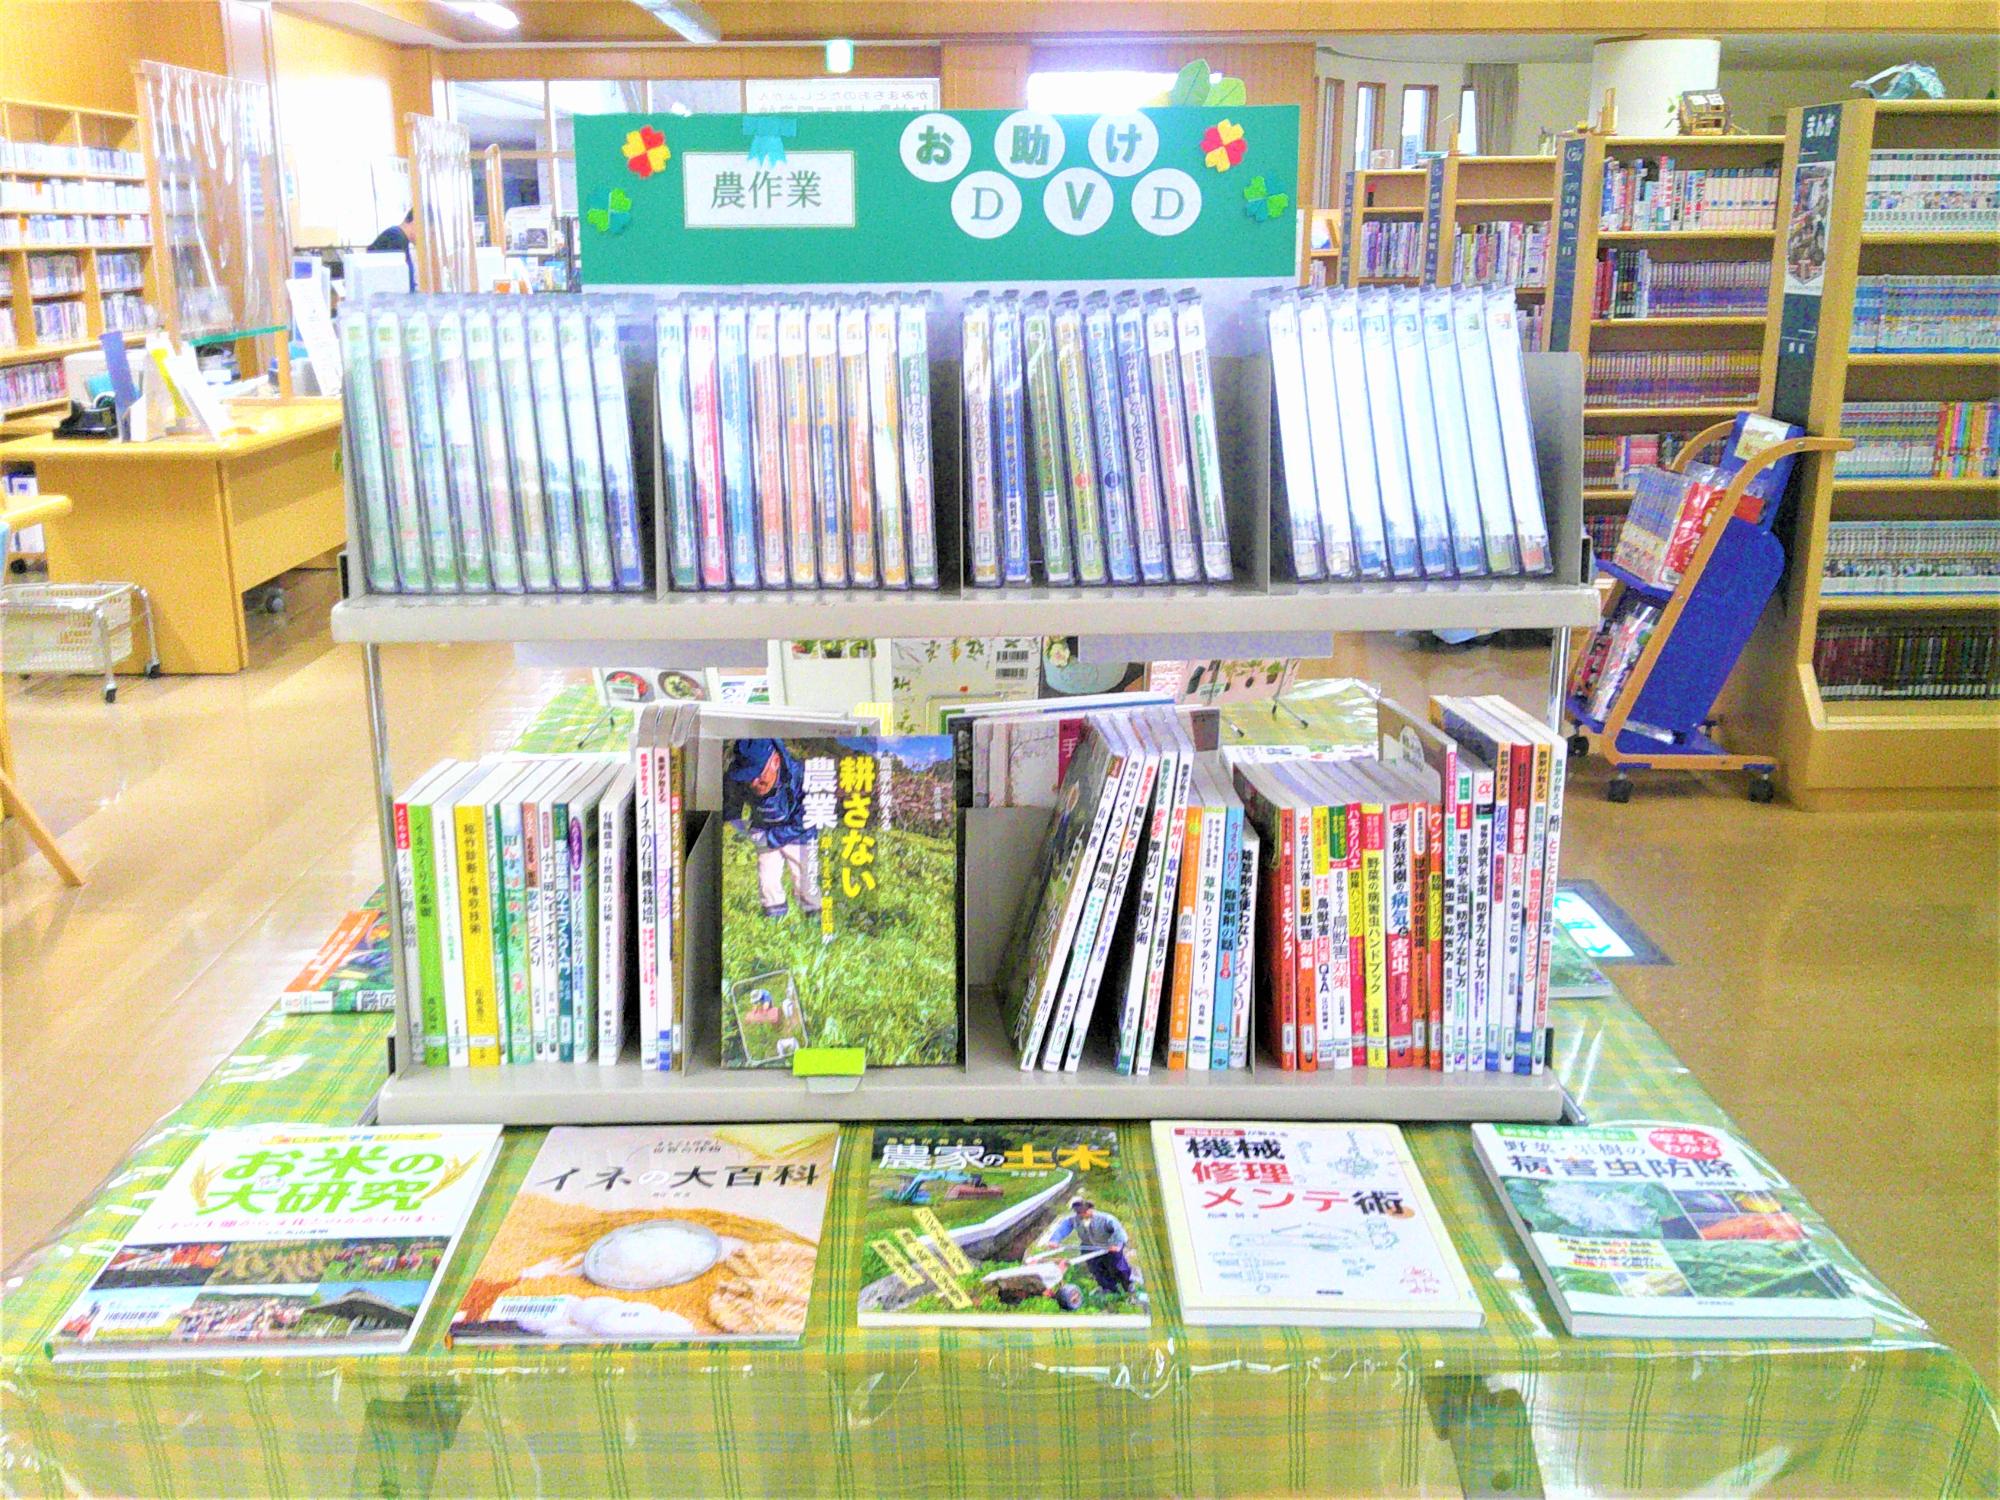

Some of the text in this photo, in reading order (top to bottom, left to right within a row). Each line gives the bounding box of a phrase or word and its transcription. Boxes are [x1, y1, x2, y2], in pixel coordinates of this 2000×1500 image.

[1806, 114, 1836, 138] まんが
[711, 170, 822, 209] 農作業
[641, 754, 650, 796] 農家が教える
[658, 756, 668, 804] 農家が教える
[802, 756, 838, 831] 農業
[879, 757, 893, 831] 農家が教える
[1158, 759, 1171, 805] 農家が教える
[1178, 764, 1190, 805] 農家が教える
[1498, 751, 1509, 799] 農家が教える
[1537, 751, 1548, 800] 農家が教える
[840, 756, 876, 898] 耕さない
[1431, 812, 1442, 858] ウンカ
[640, 799, 656, 924] イネの有機栽培
[1348, 810, 1362, 936] ハモグリバエ 防除ハンドブック
[1220, 888, 1237, 951] 除草剤の話
[1391, 823, 1410, 976] 家庭菜園の病気と害虫
[1511, 890, 1520, 955] あの手この手
[1282, 908, 1294, 961] モグラ
[1301, 914, 1314, 969] 獣害対策
[1366, 857, 1382, 994] 野菜の病害虫ハンドブック
[222, 1145, 444, 1180] お米の
[880, 1144, 1111, 1172] 農家の土木
[1185, 1137, 1286, 1160] 機械
[1507, 1158, 1736, 1178] 病害虫防除
[540, 1163, 821, 1192] イネの大百科
[1190, 1161, 1294, 1185] 修理
[196, 1179, 432, 1216] 大研究
[1202, 1187, 1404, 1216] メンテ術
